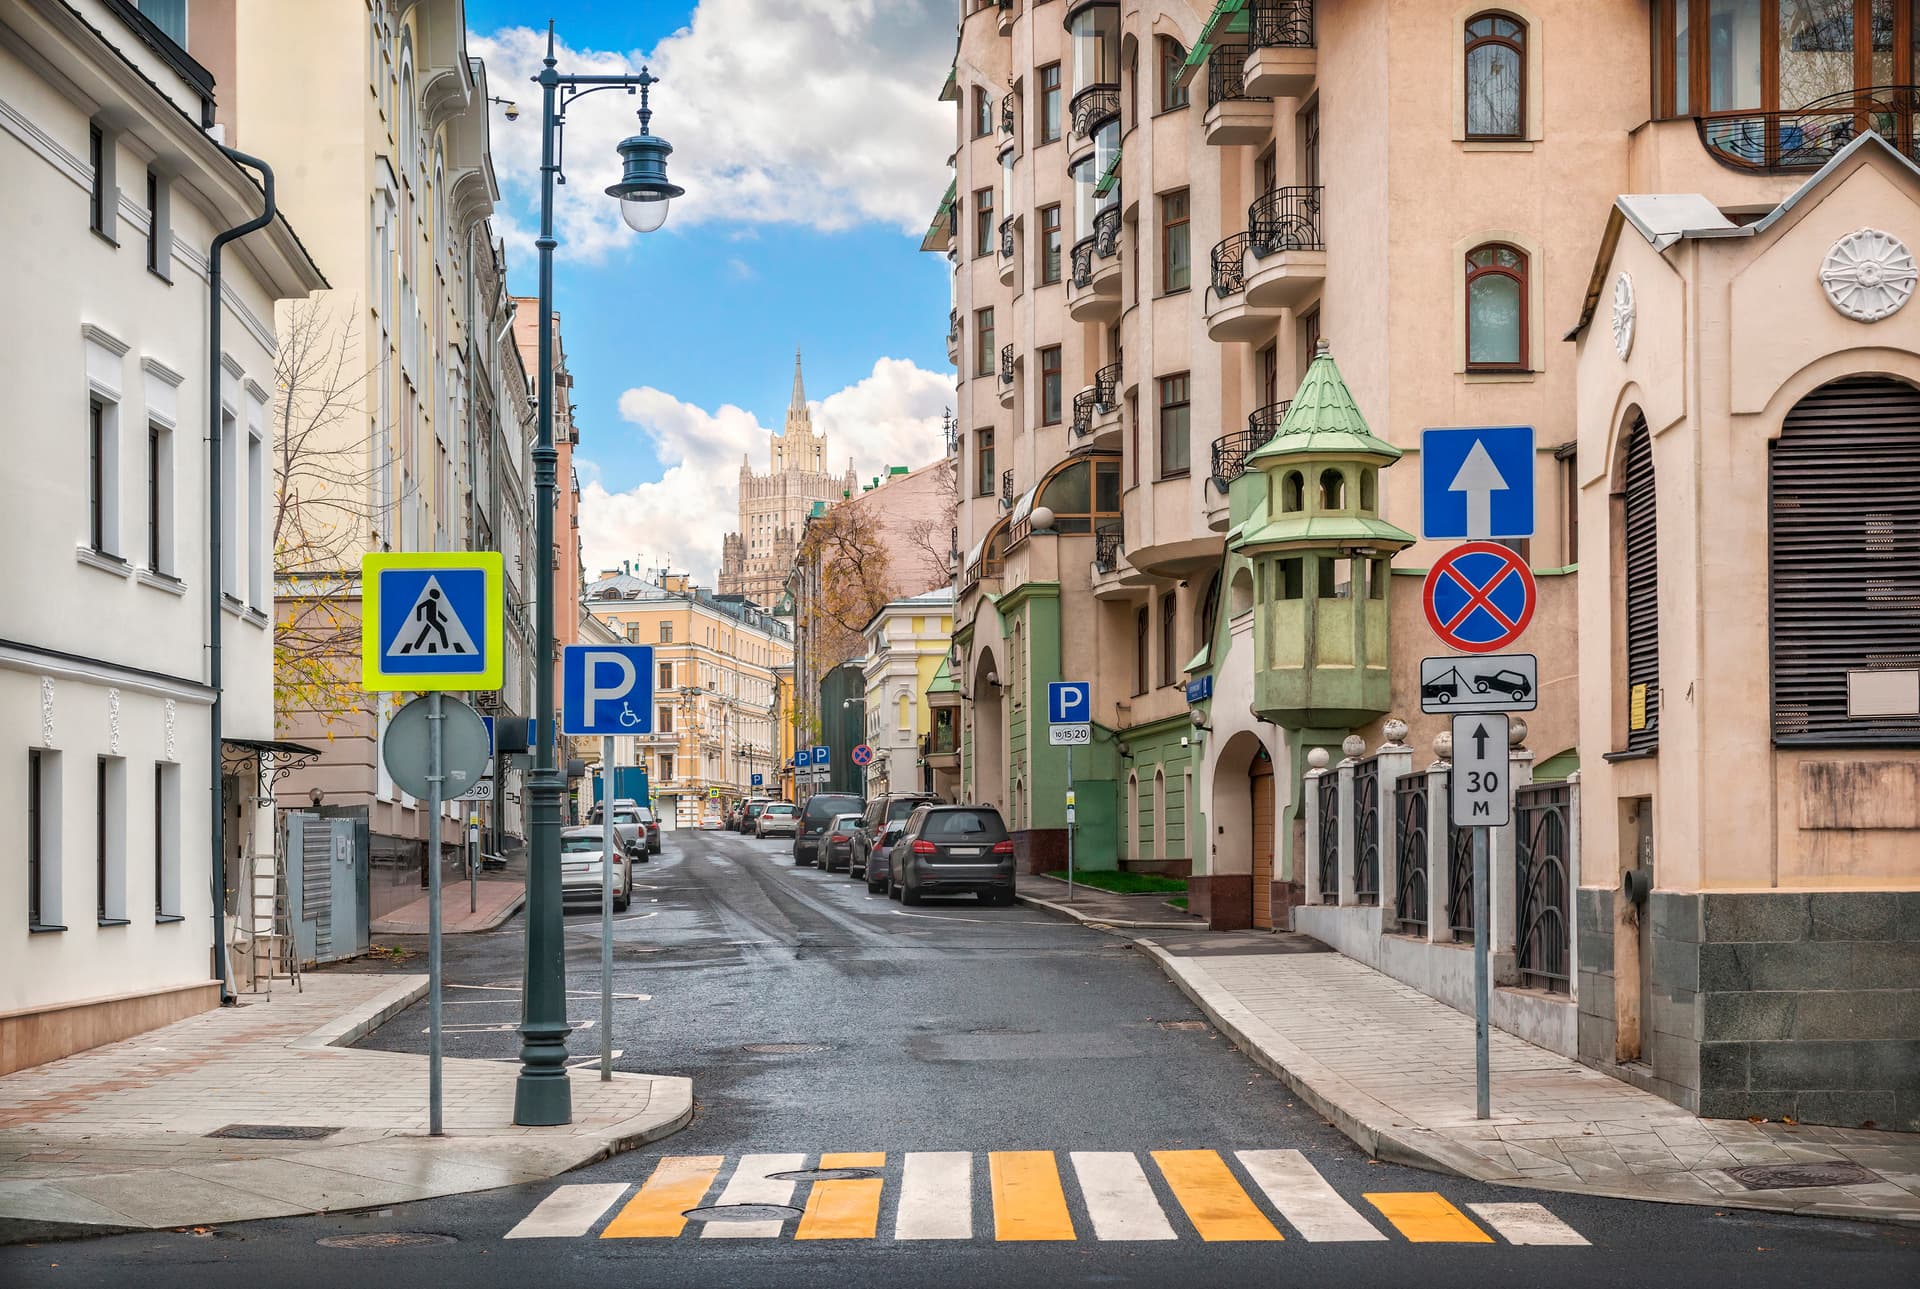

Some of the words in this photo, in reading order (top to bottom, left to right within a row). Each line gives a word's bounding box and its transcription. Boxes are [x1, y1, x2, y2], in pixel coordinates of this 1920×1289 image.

[583, 651, 636, 727] P
[1060, 686, 1083, 719] P
[1063, 730, 1072, 738] 15
[1074, 729, 1087, 739] 20
[798, 752, 808, 765] P
[816, 748, 827, 762] P
[753, 775, 761, 785] P
[1466, 771, 1498, 793] 30
[476, 785, 489, 795] 20
